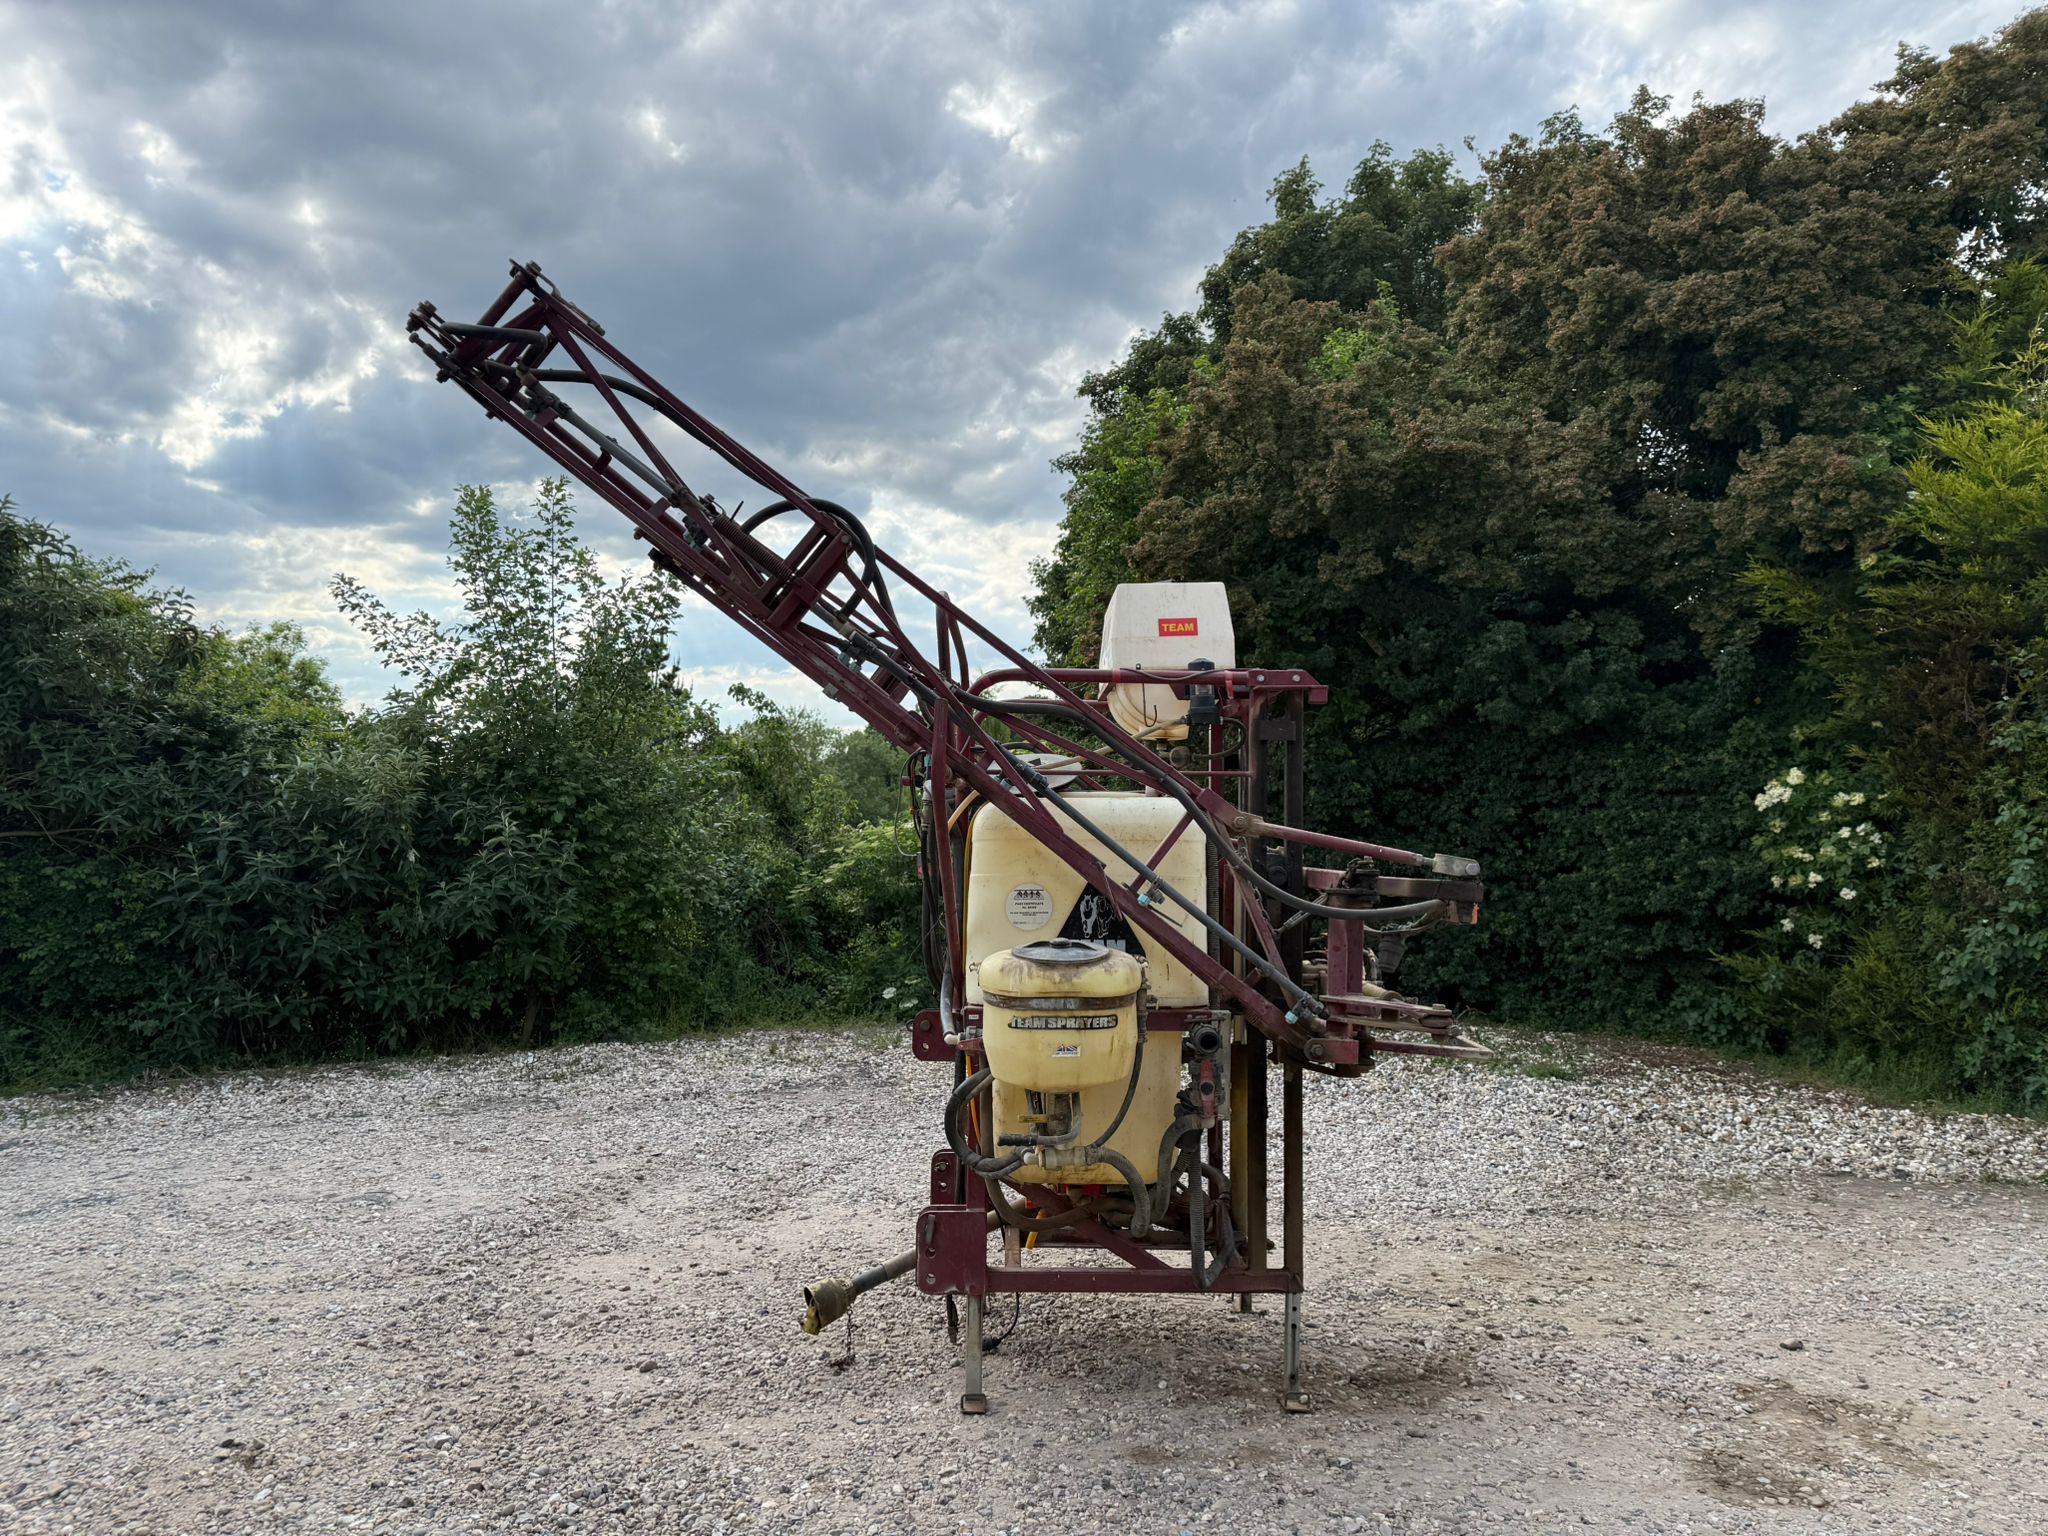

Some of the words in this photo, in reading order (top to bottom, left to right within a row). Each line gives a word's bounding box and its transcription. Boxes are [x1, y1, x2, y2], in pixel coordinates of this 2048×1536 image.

[1161, 623, 1194, 632] TEAM
[1011, 1016, 1046, 1029] TEAM
[1047, 1016, 1117, 1029] SPRAYERS
